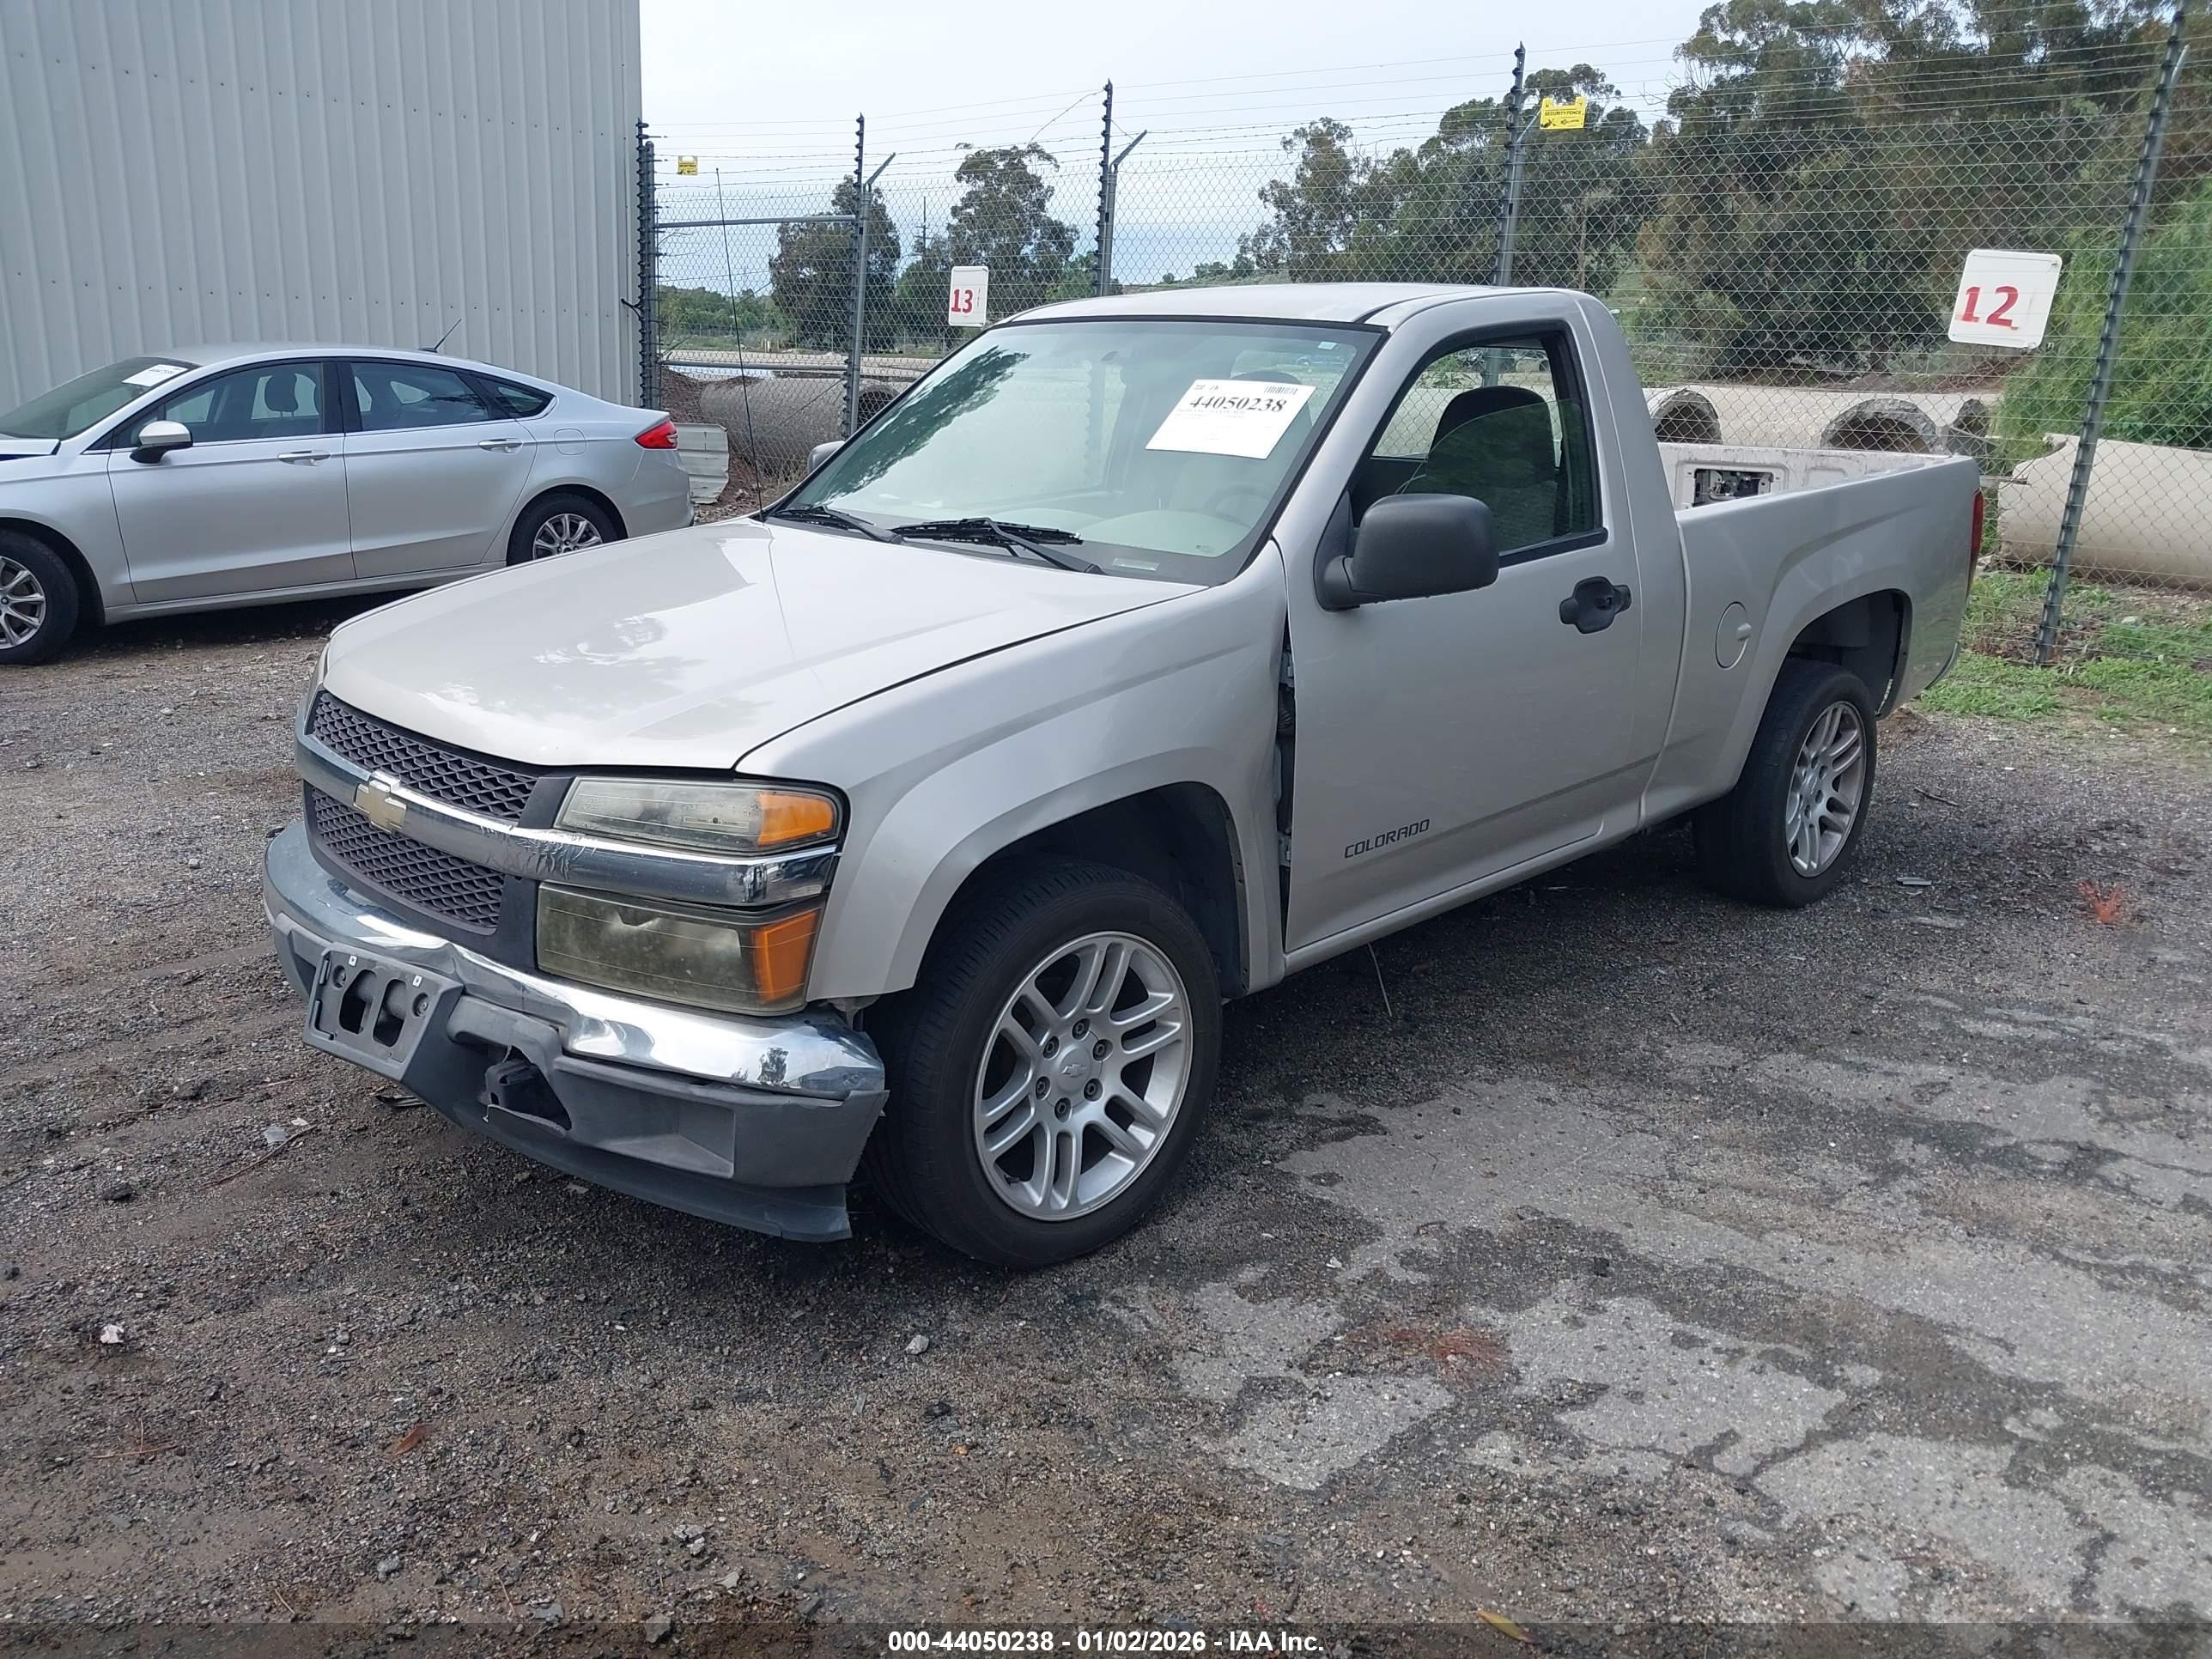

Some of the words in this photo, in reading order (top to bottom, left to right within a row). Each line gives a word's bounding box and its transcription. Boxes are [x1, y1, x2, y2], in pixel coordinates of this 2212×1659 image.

[951, 289, 973, 313] 13
[1962, 286, 2019, 327] 12
[1189, 395, 1287, 412] 44050238
[1344, 818, 1430, 859] COLORADO
